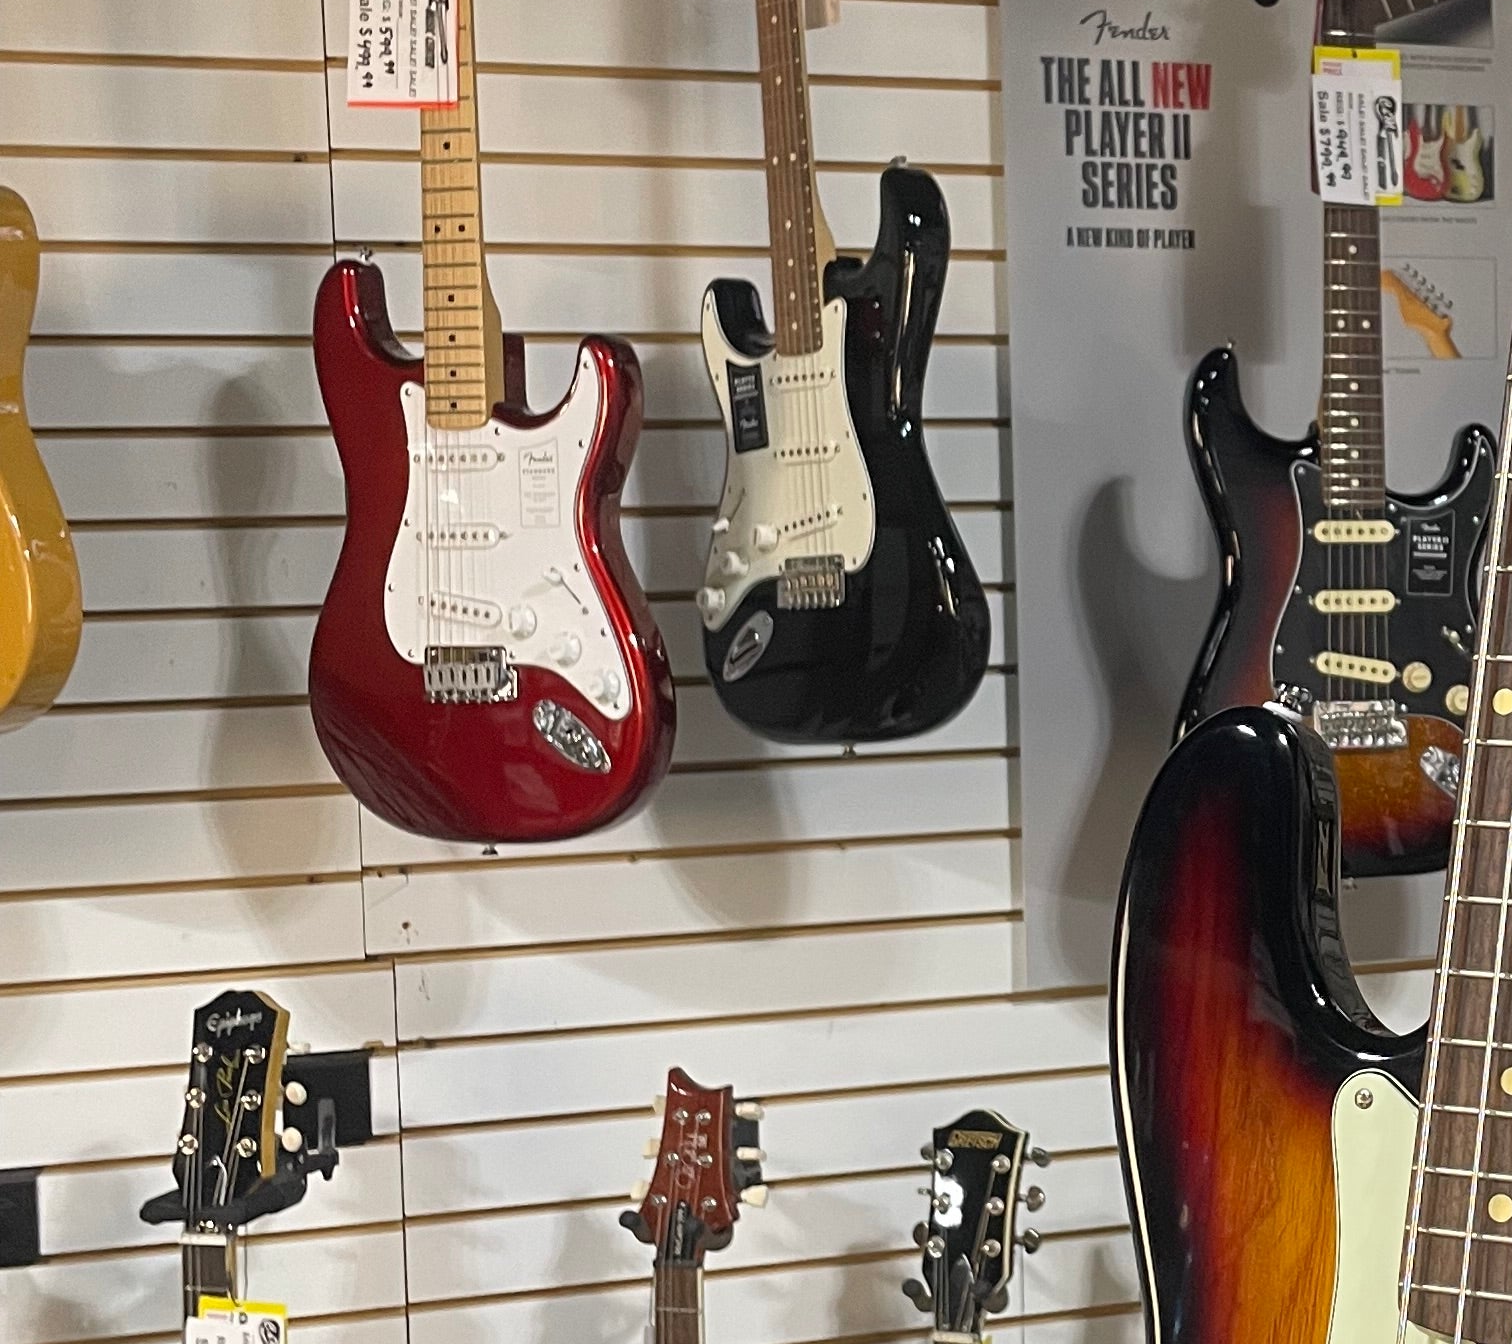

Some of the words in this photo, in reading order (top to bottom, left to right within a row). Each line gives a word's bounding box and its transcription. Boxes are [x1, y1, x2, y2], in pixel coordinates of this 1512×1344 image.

[1079, 10, 1170, 45] Fender
[1041, 56, 1091, 106] THE
[1099, 59, 1145, 108] ALL
[1152, 63, 1212, 110] NEW
[1317, 91, 1329, 122] Sale
[1064, 109, 1166, 160] PLAYER
[1173, 113, 1191, 161] II
[1081, 161, 1178, 211] SERIES
[1066, 227, 1076, 248] A
[1077, 227, 1103, 248] NEW
[1106, 227, 1135, 248] KIND
[1137, 228, 1151, 249] OF
[1153, 229, 1196, 250] PLAYER
